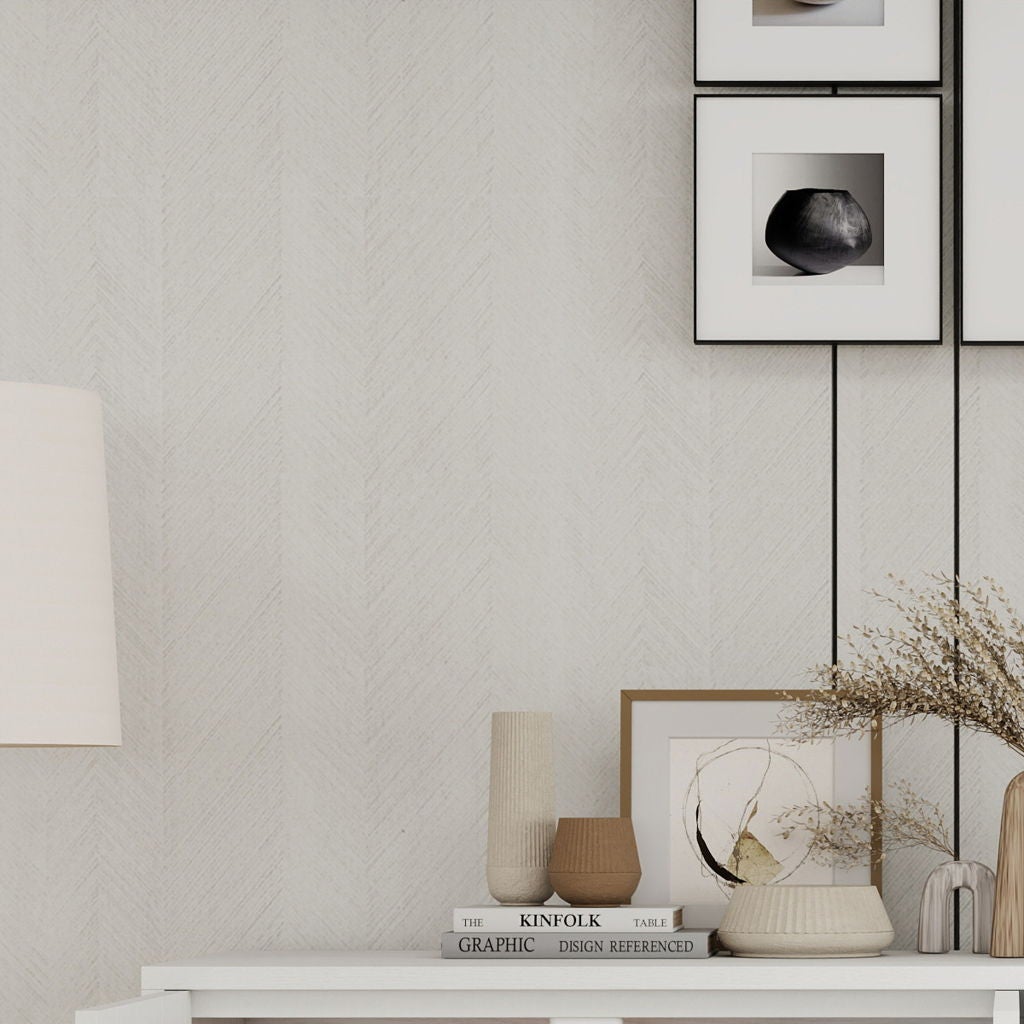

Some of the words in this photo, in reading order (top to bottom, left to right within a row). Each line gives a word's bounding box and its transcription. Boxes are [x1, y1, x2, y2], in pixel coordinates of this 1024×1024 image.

[462, 918, 484, 928] THE
[520, 913, 602, 928] KINFOLK
[633, 918, 668, 928] TABLE
[458, 937, 536, 953] GRAPHIC
[559, 940, 604, 953] DISIGN
[609, 940, 695, 953] REFERENCED
